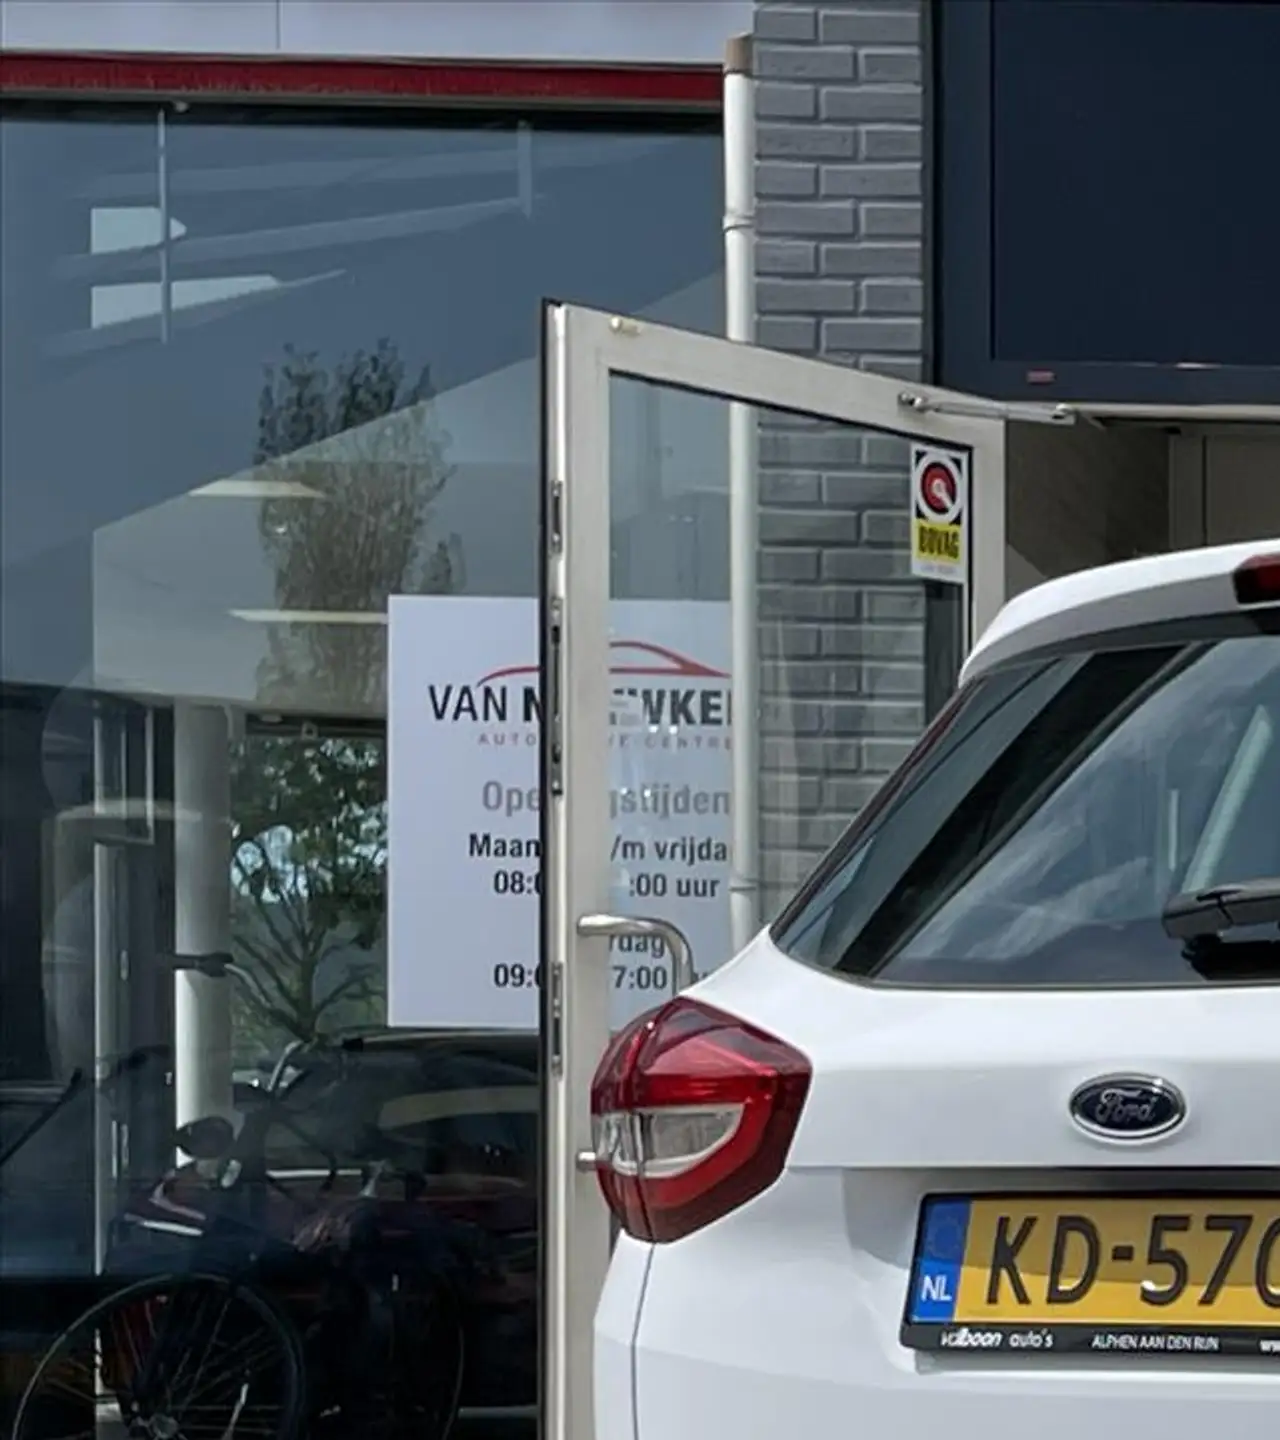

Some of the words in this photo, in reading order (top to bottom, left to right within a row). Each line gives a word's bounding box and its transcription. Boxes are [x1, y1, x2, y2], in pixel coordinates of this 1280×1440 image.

[429, 685, 507, 722] VAN
[655, 836, 727, 866] vrijda
[676, 878, 720, 897] uur
[613, 966, 667, 990] 7:00
[1095, 1087, 1159, 1124] Ford
[921, 1275, 952, 1301] NL
[1009, 1328, 1053, 1348] auto's
[1092, 1333, 1138, 1349] ALPHEN
[1140, 1334, 1165, 1350] AAN
[1166, 1335, 1192, 1350] DEN
